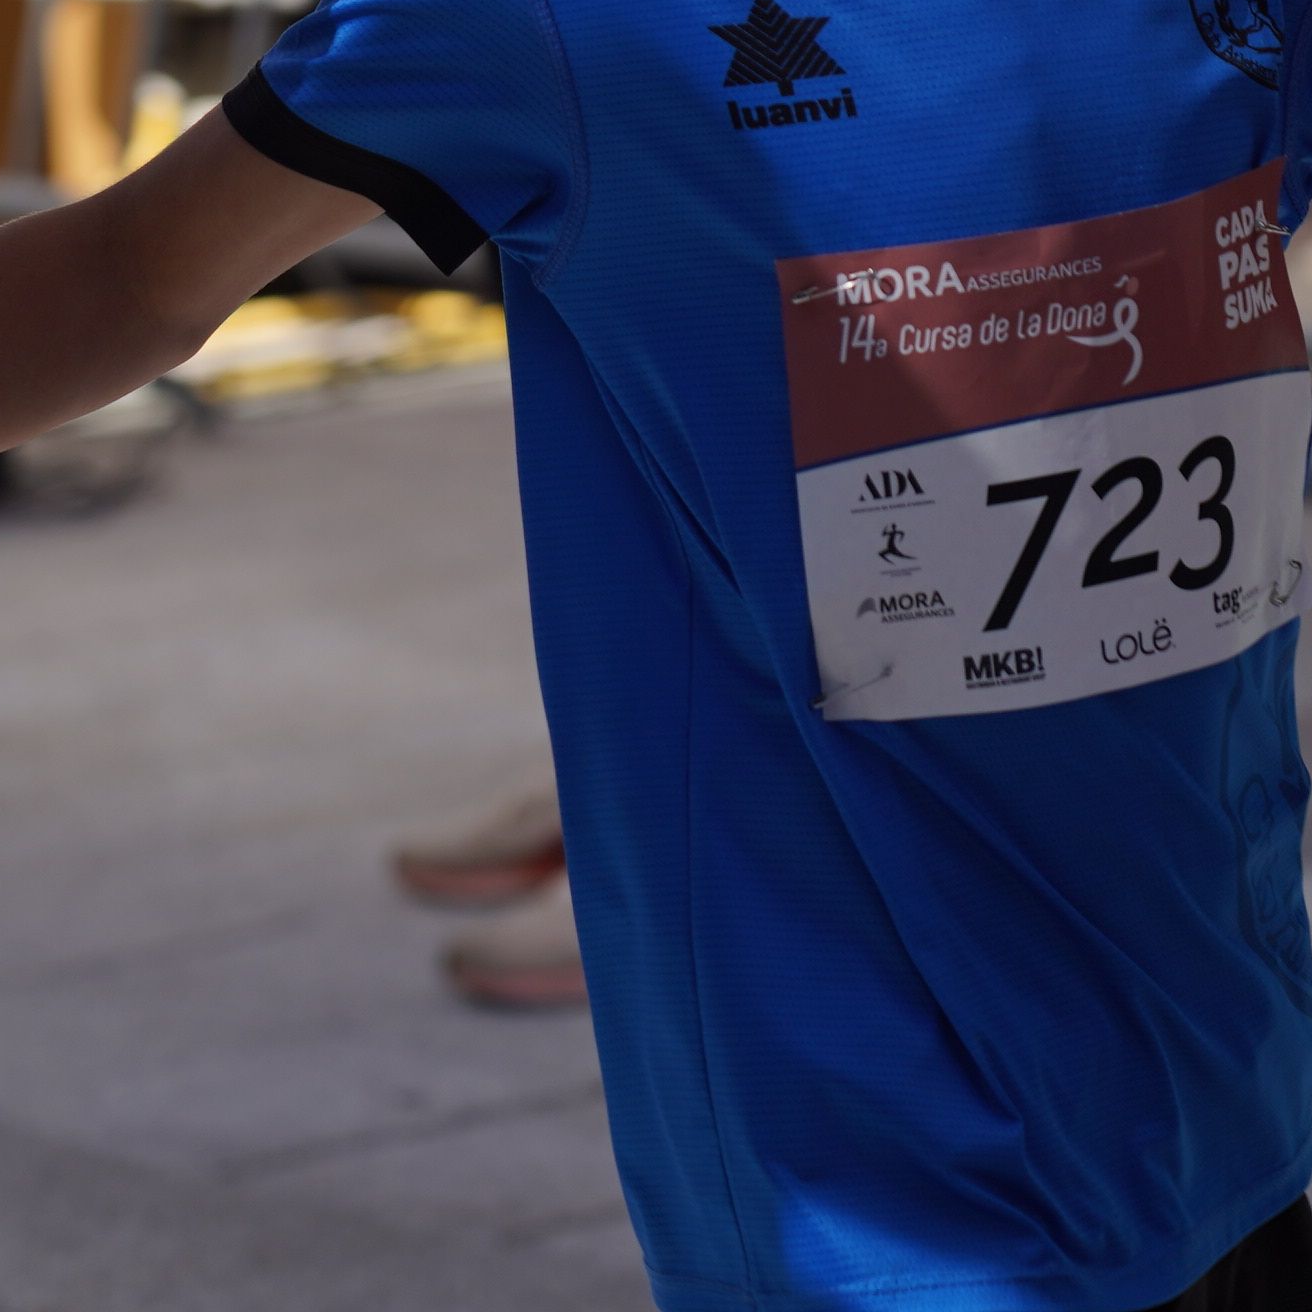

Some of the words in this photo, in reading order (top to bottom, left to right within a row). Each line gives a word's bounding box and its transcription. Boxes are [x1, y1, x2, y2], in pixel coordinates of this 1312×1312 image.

[726, 87, 858, 131] luanvi
[1215, 199, 1268, 248] CADA
[837, 261, 965, 305] MORA
[965, 256, 1103, 293] ASSEGURANCES
[1218, 233, 1271, 290] PAS
[1224, 275, 1279, 329] SUMA
[899, 323, 973, 366] Cursa
[979, 313, 1010, 346] de
[1017, 309, 1042, 339] la
[1046, 301, 1108, 336] Dona
[982, 433, 1237, 633] 723
[879, 589, 946, 614] MORA
[880, 606, 956, 625] ASSEGURANCES
[963, 645, 1045, 681] MKB!
